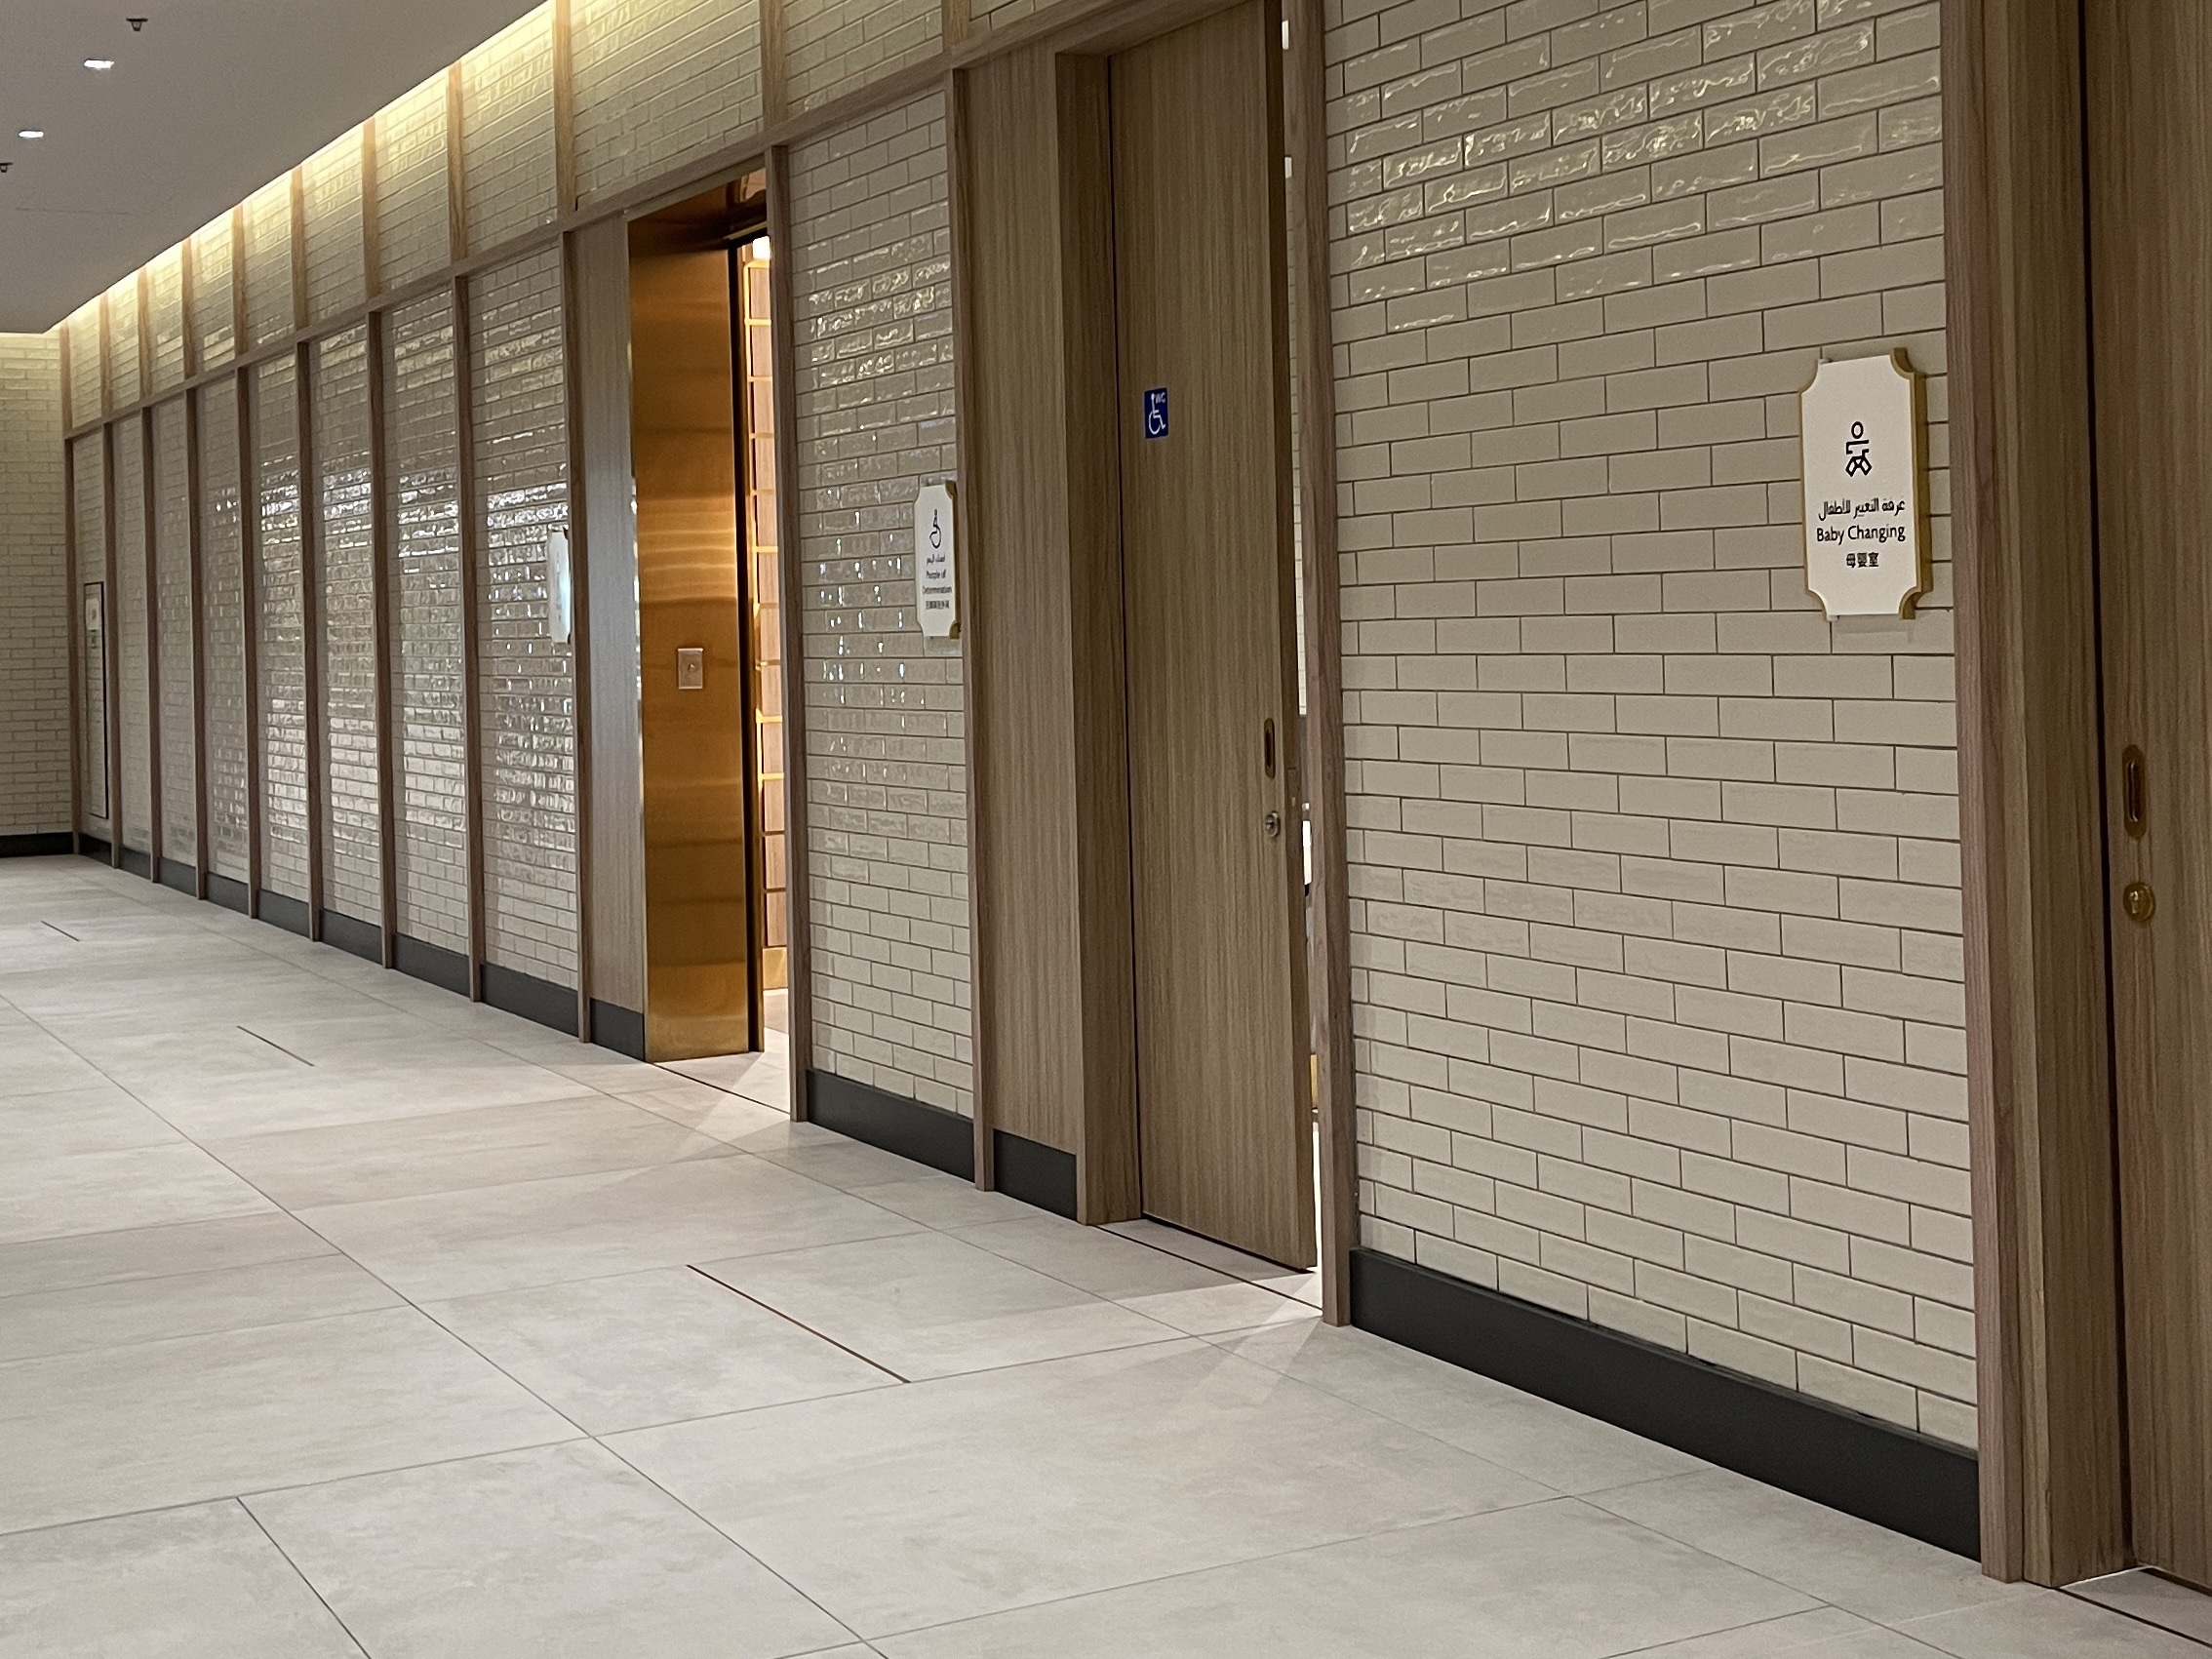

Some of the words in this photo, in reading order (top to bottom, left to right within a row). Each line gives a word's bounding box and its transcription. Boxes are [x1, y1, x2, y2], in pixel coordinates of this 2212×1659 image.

[1155, 392, 1166, 404] WC
[1881, 494, 1906, 517] غرفة
[1816, 526, 1844, 546] Baby
[1847, 524, 1906, 543] Changing
